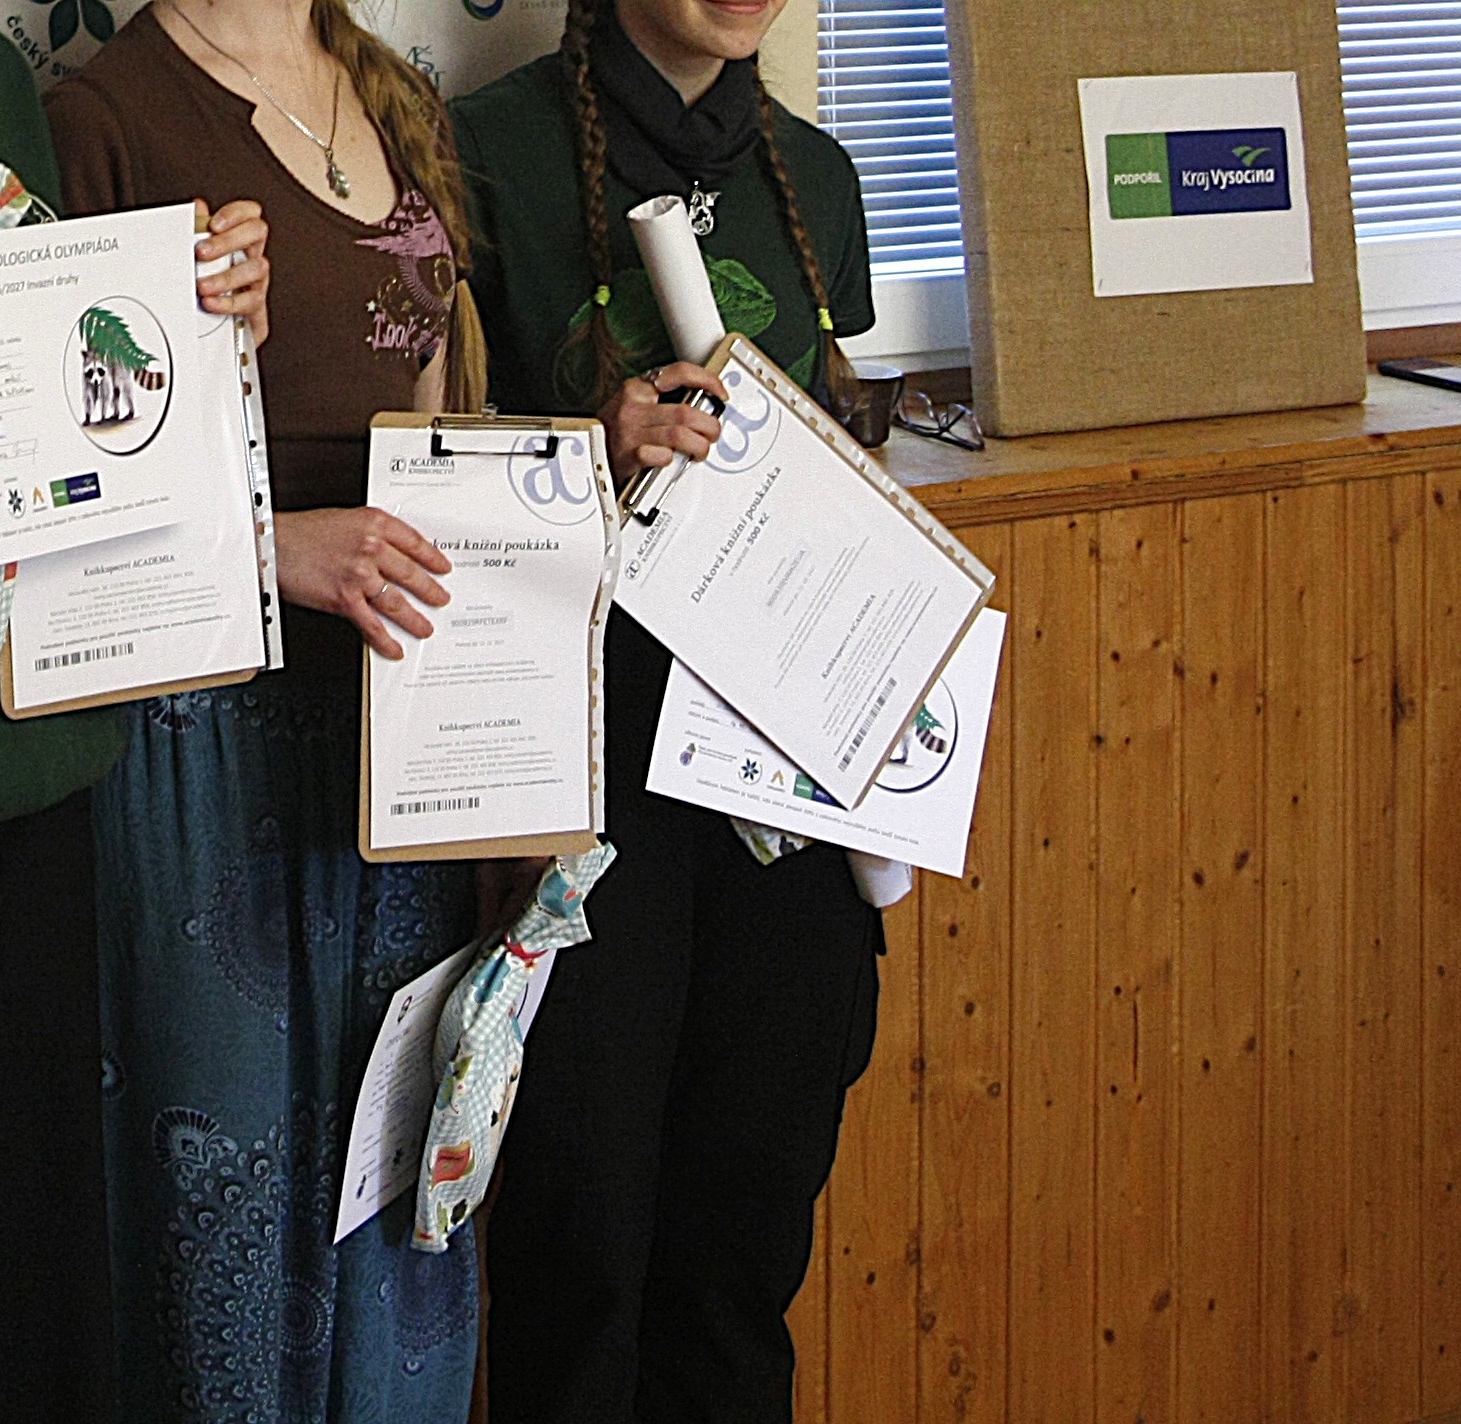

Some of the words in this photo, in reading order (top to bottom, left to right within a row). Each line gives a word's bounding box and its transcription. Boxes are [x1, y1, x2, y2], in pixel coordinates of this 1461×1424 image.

[1181, 170, 1210, 192] Kraj
[53, 236, 119, 260] OLYMPIÁDA
[371, 313, 418, 351] Look
[410, 459, 455, 468] ACADEMIA
[690, 553, 726, 603] Dárková
[719, 518, 748, 556] knižní
[744, 466, 782, 522] poukázka
[432, 538, 460, 551] ková
[463, 537, 502, 551] knižní
[504, 537, 559, 554] poukázka
[132, 554, 175, 568] ACADEMIA
[482, 558, 502, 568] 500
[503, 558, 517, 568] Kč
[483, 718, 521, 727] ACADEMIA
